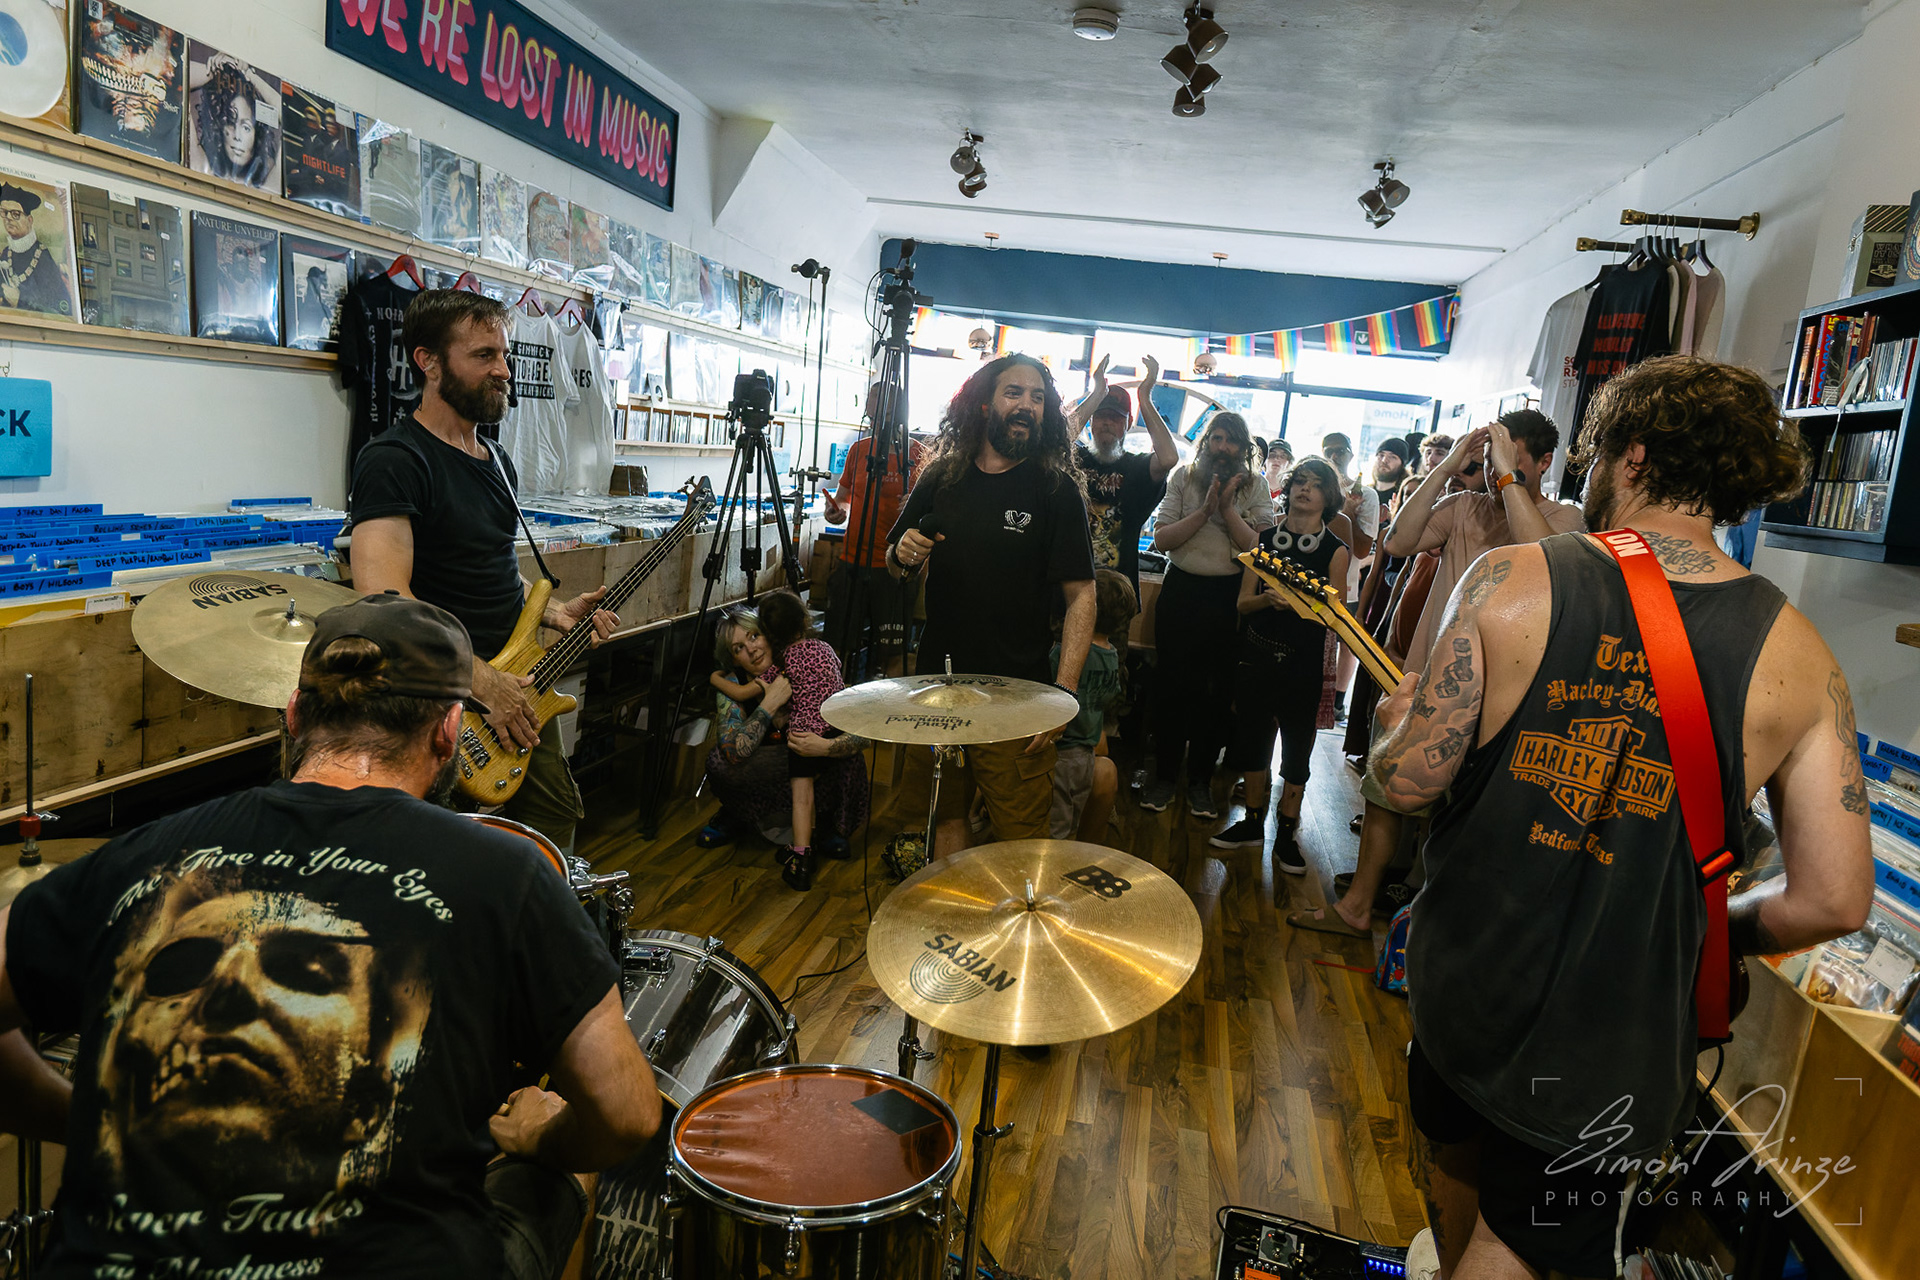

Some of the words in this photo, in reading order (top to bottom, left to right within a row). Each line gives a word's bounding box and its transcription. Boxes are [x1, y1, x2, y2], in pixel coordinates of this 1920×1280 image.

[480, 10, 561, 128] LOST
[563, 63, 595, 148] IN
[599, 85, 673, 188] MUSIC
[302, 153, 347, 180] NIGHTLIFE
[198, 216, 232, 233] NATURE
[234, 224, 276, 241] UNVEILED
[96, 558, 116, 568] DEEP
[13, 582, 34, 592] BOYS
[192, 583, 289, 610] SABIAN
[1596, 634, 1651, 678] Tex
[1512, 771, 1551, 790] TRADE
[1624, 802, 1660, 820] MARK
[178, 846, 256, 878] Fire
[262, 849, 296, 868] in
[299, 846, 389, 877] Your
[393, 868, 455, 924] Eyes
[1062, 865, 1132, 898] B8
[923, 933, 1017, 993] SABIAN
[222, 1190, 365, 1236] Fades
